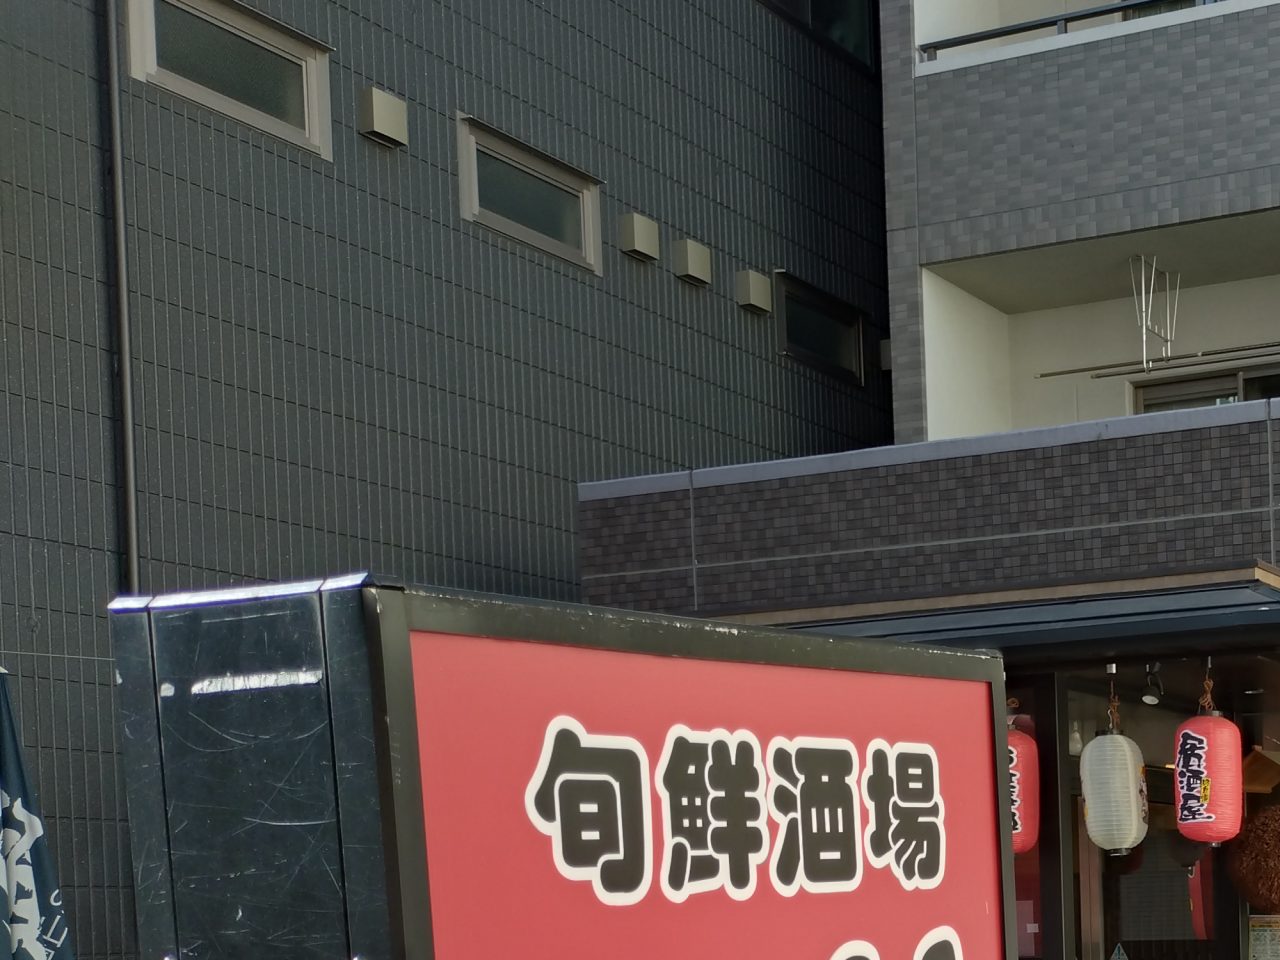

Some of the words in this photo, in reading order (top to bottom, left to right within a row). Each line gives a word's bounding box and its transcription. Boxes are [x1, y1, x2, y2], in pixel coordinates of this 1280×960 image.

[525, 715, 946, 905] 旬鮮酒場
[1177, 730, 1215, 822] 居酒屋
